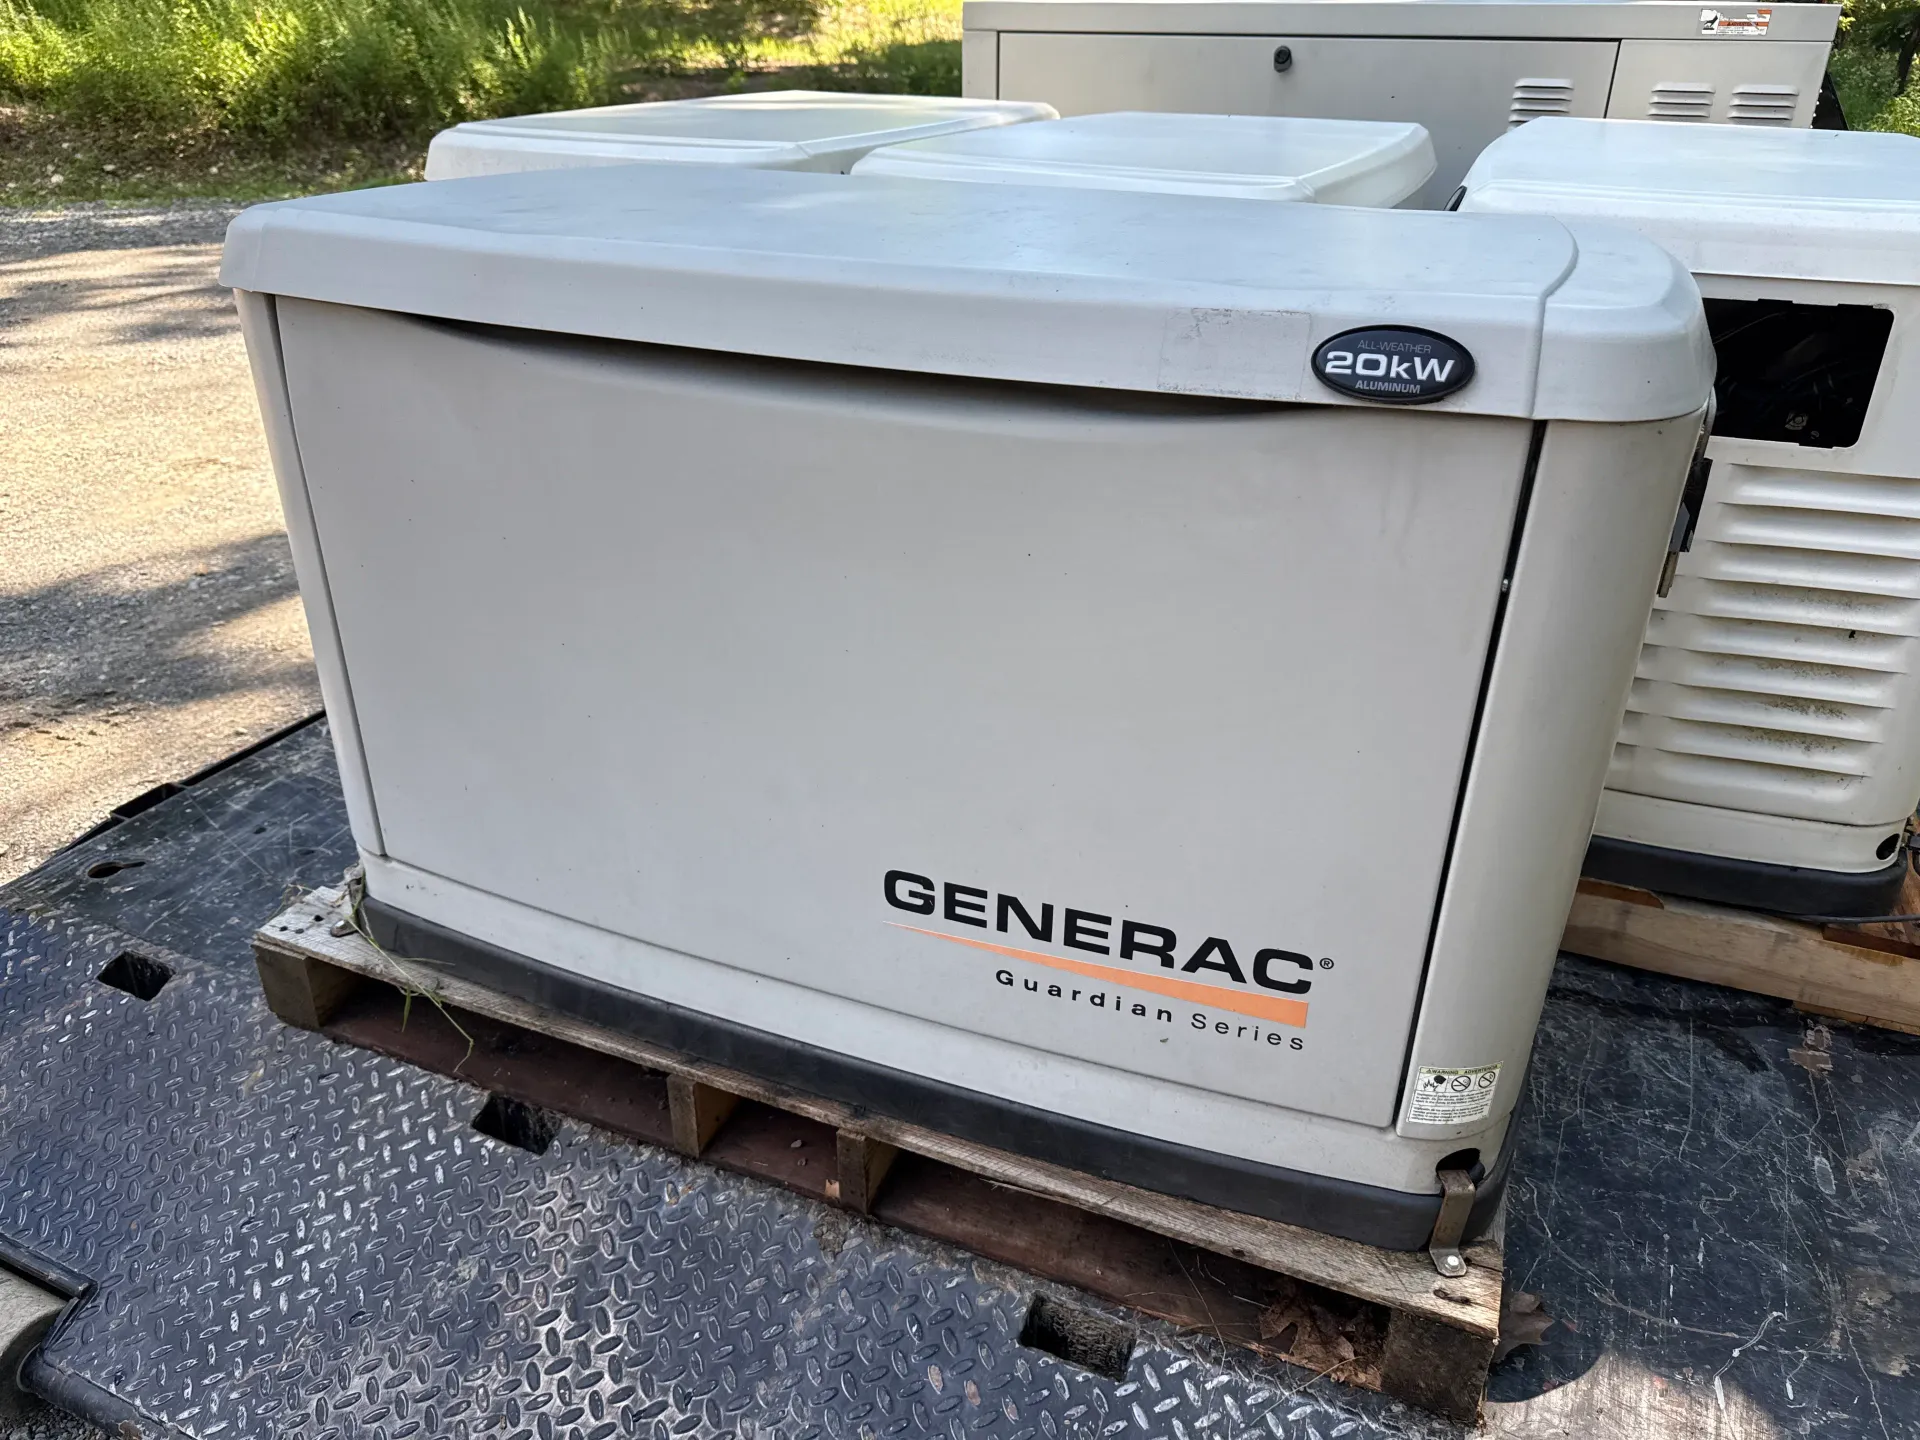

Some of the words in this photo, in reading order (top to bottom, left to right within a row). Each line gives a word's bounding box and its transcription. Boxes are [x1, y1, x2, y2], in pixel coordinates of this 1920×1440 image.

[1357, 339, 1432, 354] ALL-WEATHER
[1325, 351, 1456, 383] 20kW
[1355, 379, 1421, 395] ALUMINUM
[995, 969, 1173, 1023] Guardian
[1190, 1012, 1304, 1052] Series
